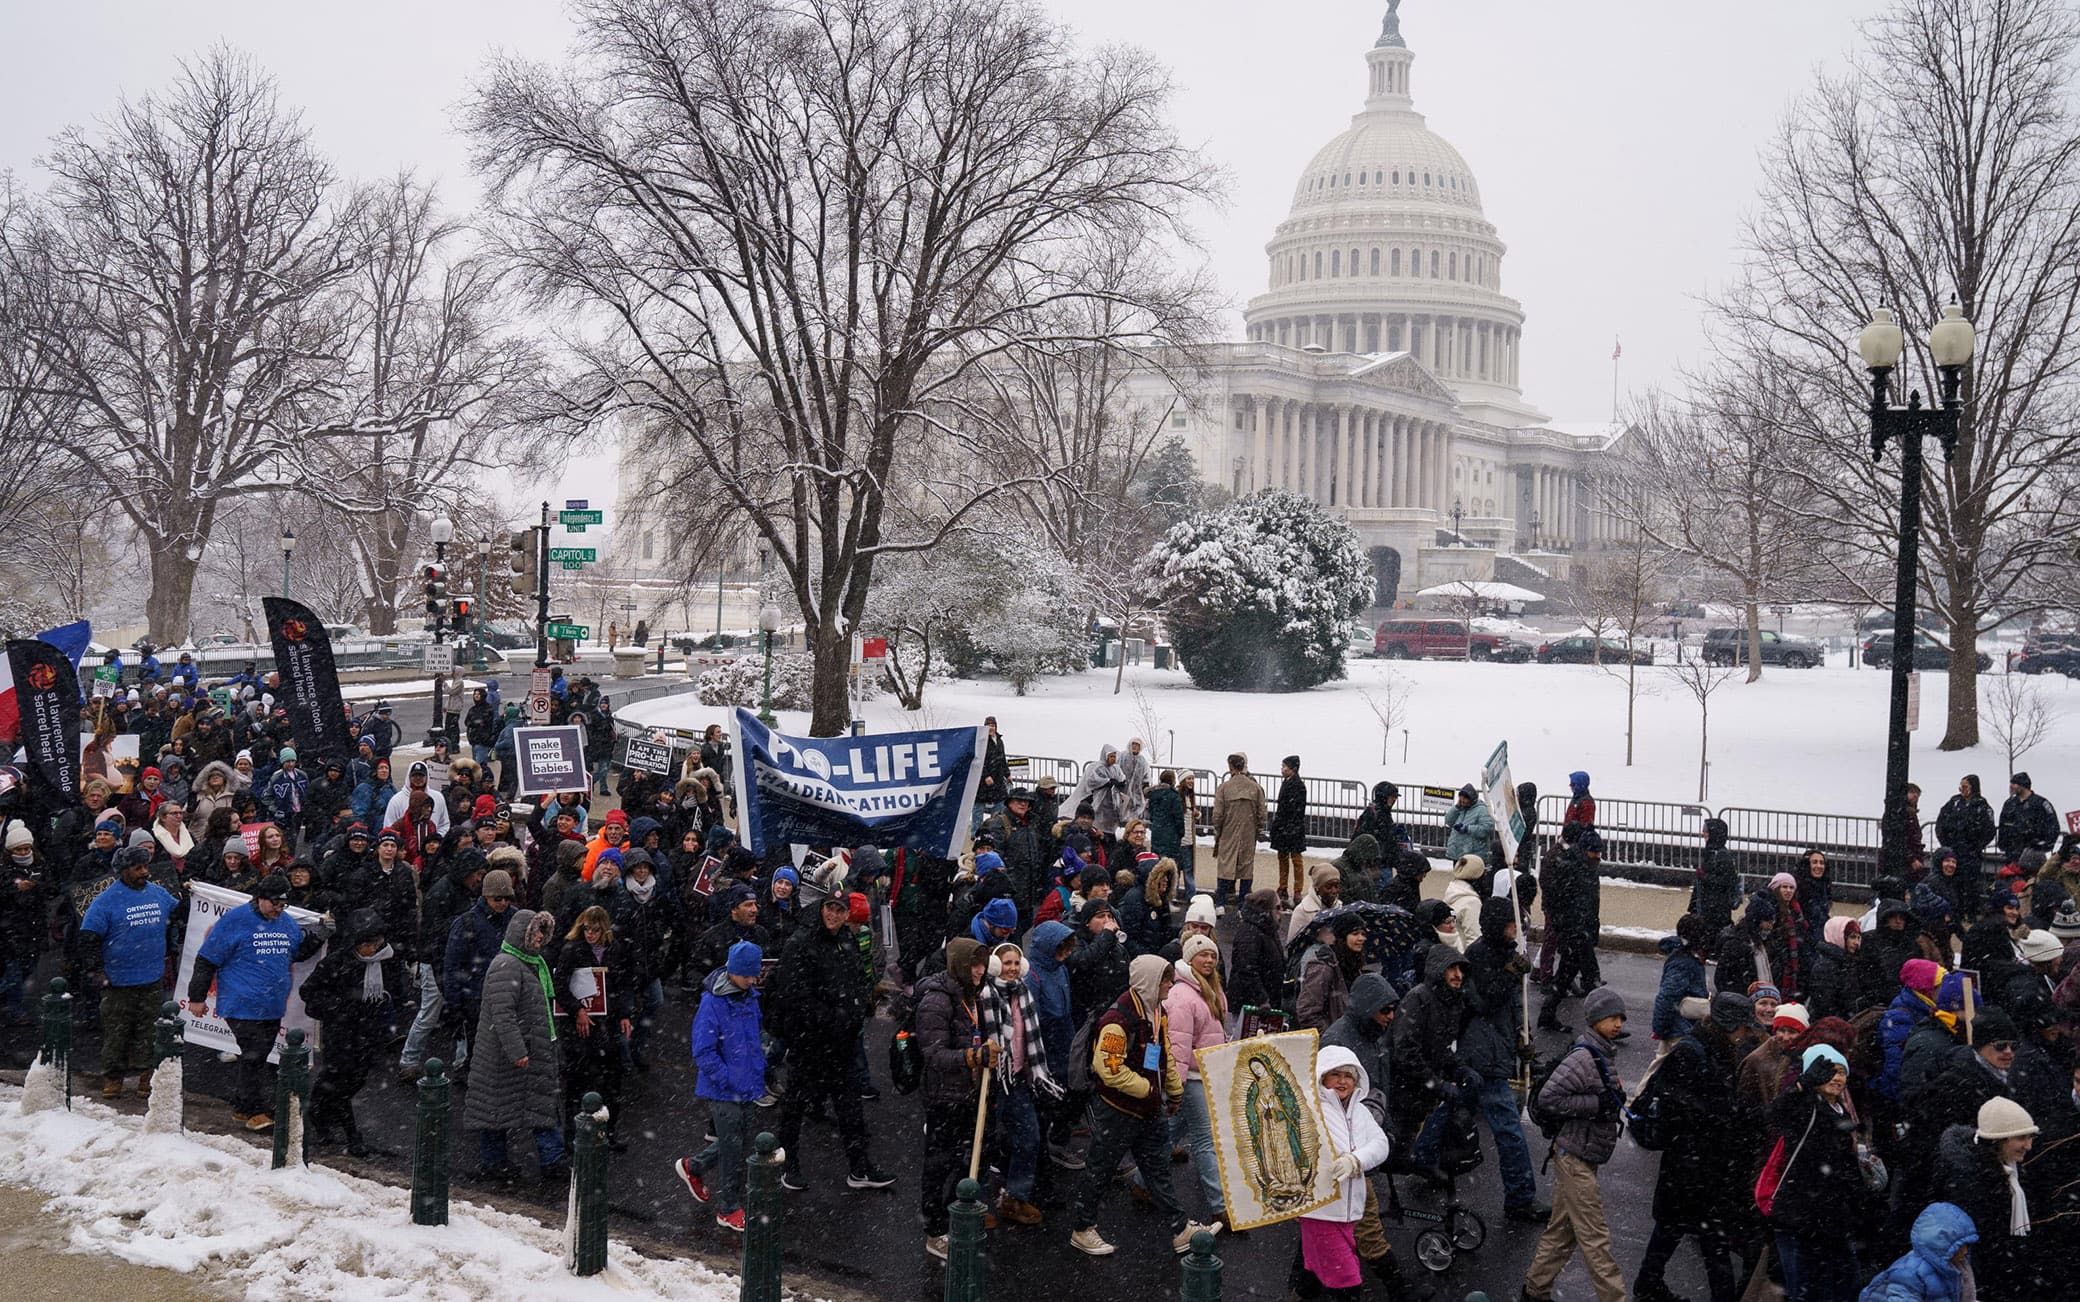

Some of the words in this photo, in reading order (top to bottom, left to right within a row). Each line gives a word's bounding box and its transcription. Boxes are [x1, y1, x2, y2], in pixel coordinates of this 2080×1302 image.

[563, 511, 594, 525] Independence
[568, 524, 584, 532] UNIT
[551, 549, 587, 561] CAPITOL
[564, 561, 581, 569] 100
[288, 645, 302, 678] sacred
[302, 652, 317, 699] lawrence
[48, 691, 58, 700] st
[294, 676, 307, 706] heart
[34, 694, 52, 732] sacred
[49, 700, 65, 755] lawrence
[40, 733, 55, 762] heart
[530, 739, 560, 750] make
[531, 750, 560, 760] more
[629, 749, 668, 764] PRO-LIFE
[652, 748, 667, 756] THE
[533, 763, 573, 774] babies.
[628, 757, 667, 770] GENERATION
[848, 792, 932, 813] CATHOLI
[126, 903, 160, 914] ORTHODOX
[197, 900, 209, 913] 10
[126, 910, 162, 921] CHRISTIANS
[190, 1019, 233, 1037] TELEGRAM:
